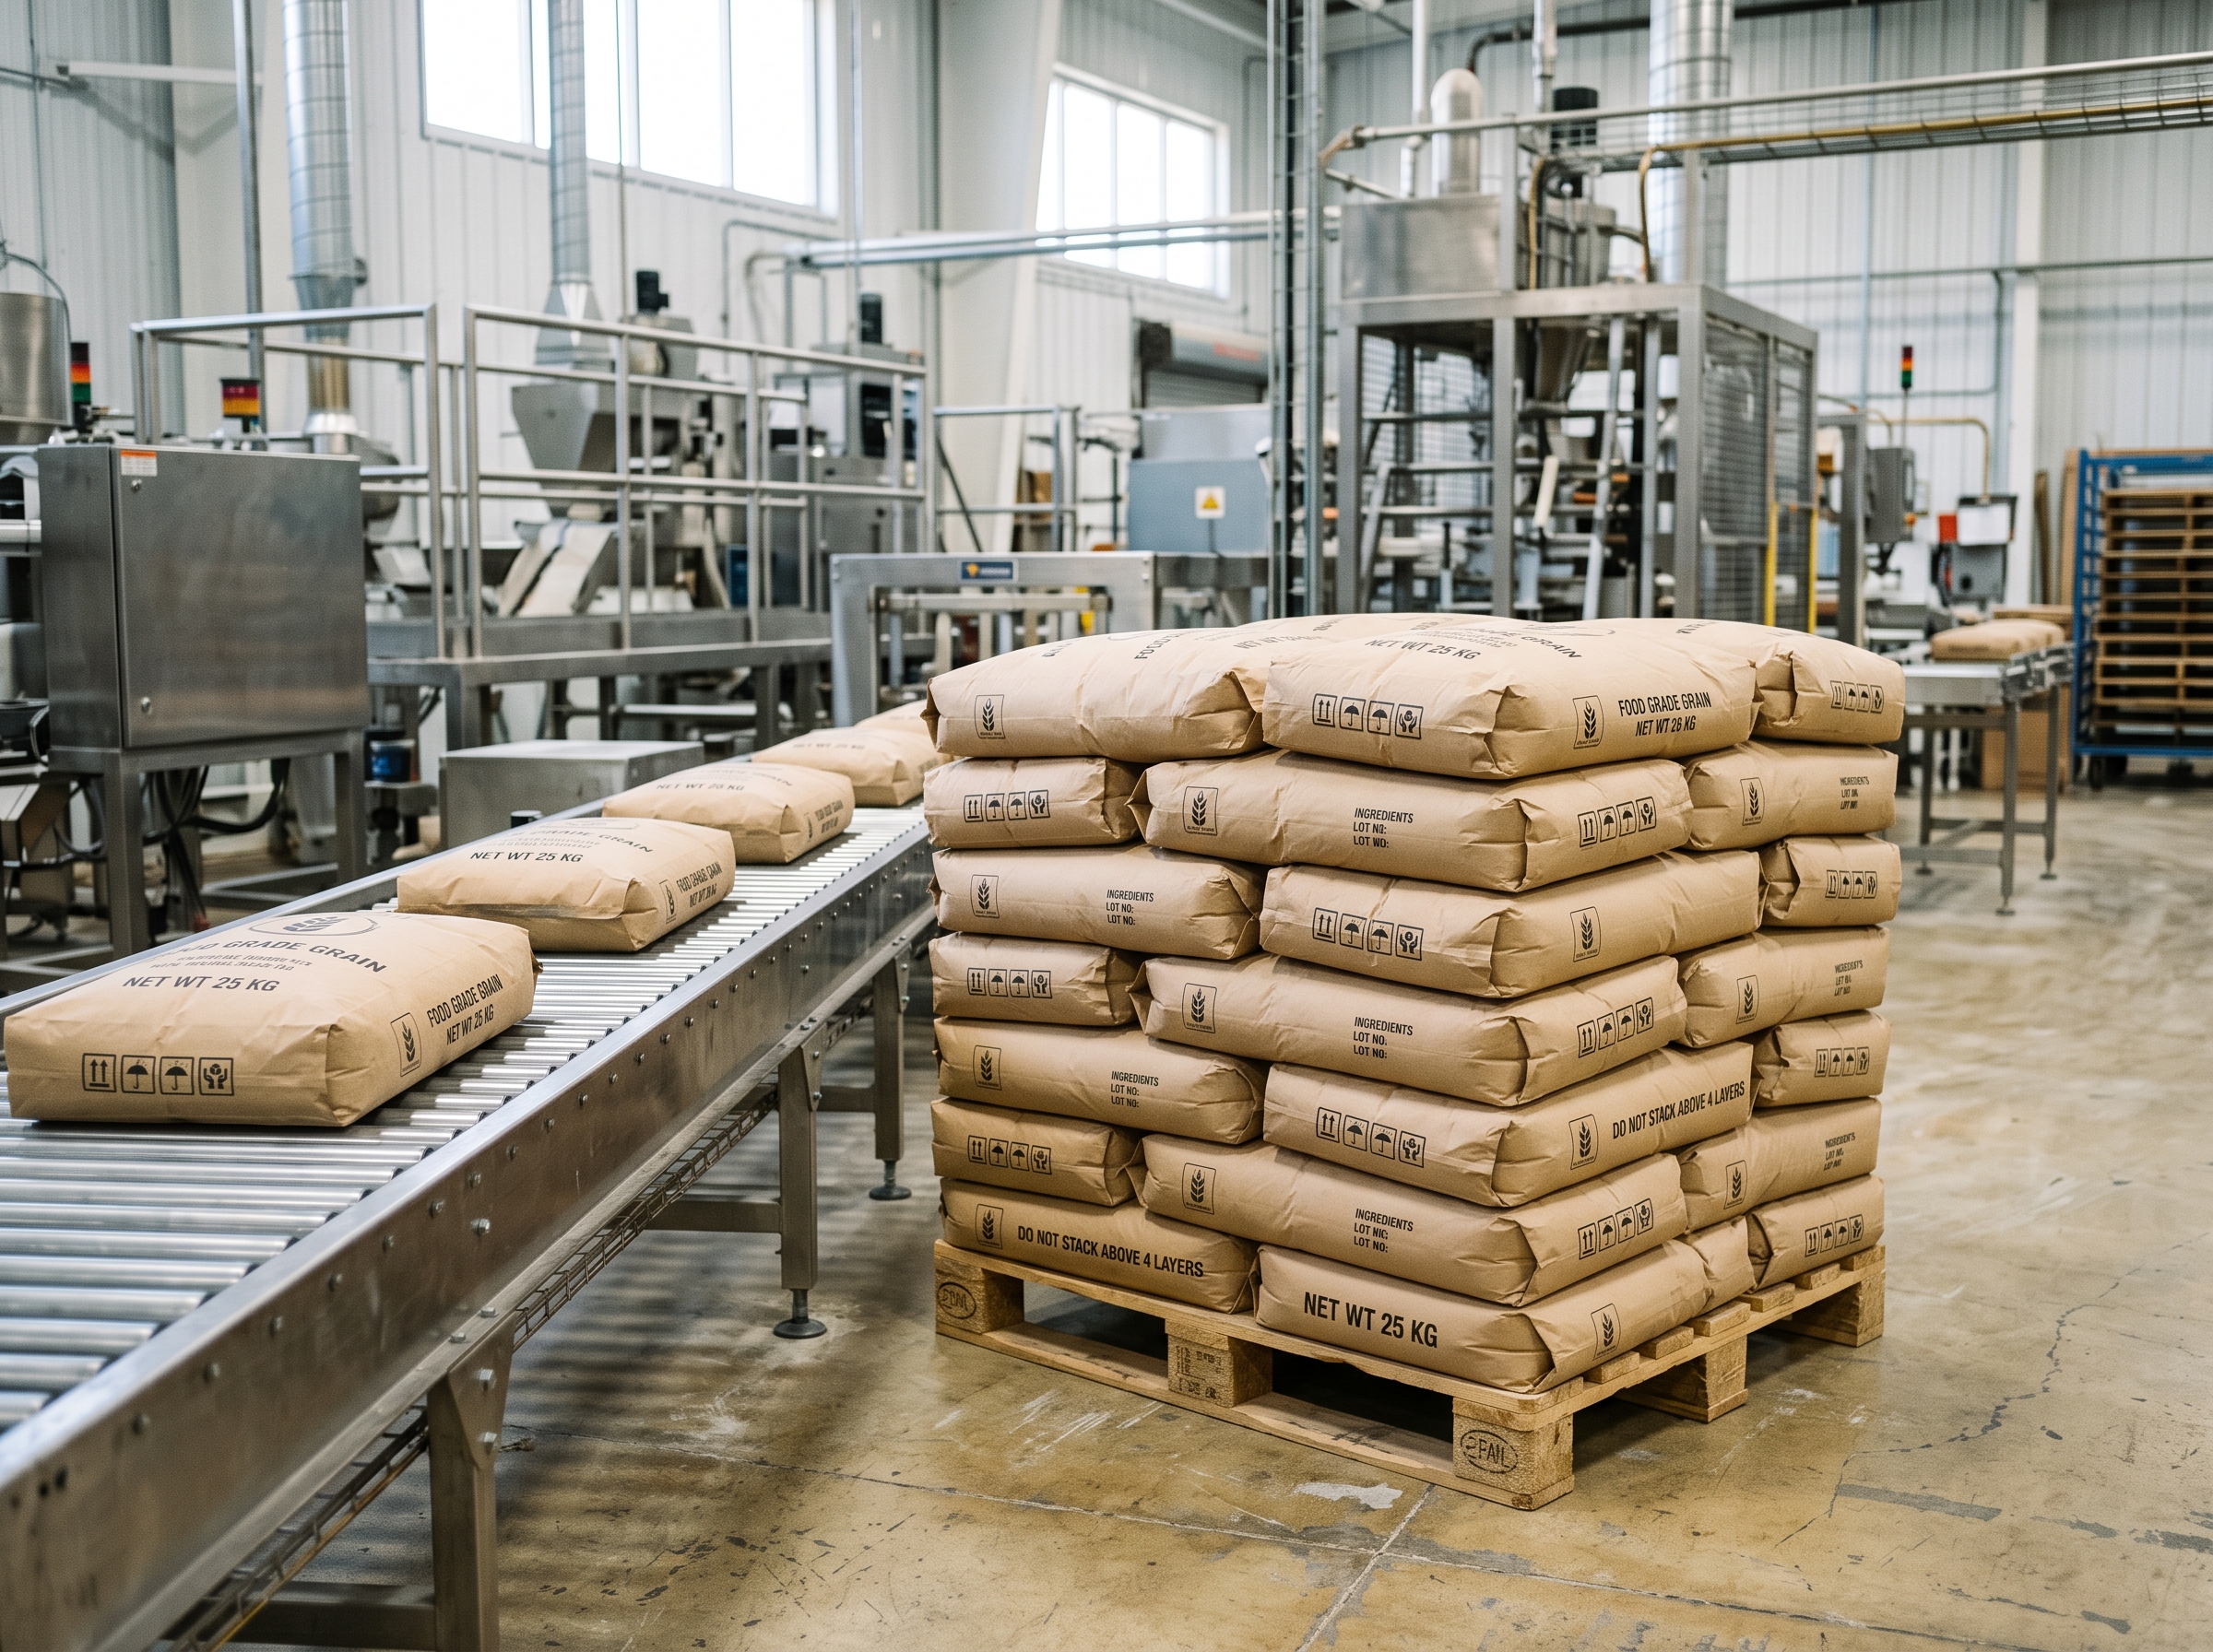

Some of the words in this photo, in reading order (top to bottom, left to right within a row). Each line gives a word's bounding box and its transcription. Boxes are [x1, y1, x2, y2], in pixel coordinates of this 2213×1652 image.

[1618, 698, 1646, 716] FOOD
[1647, 694, 1680, 714] GRADE
[1681, 691, 1711, 710] GRAIN
[1635, 719, 1653, 737] NET
[1655, 717, 1670, 734] WT
[1684, 715, 1697, 731] KG
[1354, 808, 1414, 824] INGREDIENTS
[1353, 821, 1370, 833] LOT
[1353, 835, 1371, 846] LOT
[470, 852, 504, 860] NET
[507, 852, 534, 861] WT
[535, 852, 558, 861] 25
[560, 853, 584, 863] KG
[1106, 889, 1154, 903] INGREDIENTS
[1106, 902, 1120, 912] LOT
[1121, 903, 1134, 914] NO:
[1106, 914, 1121, 925] LOT
[1122, 915, 1136, 926] NO:
[222, 940, 307, 950] GRADE
[309, 945, 387, 973] GRAIN
[123, 975, 172, 988] NET
[174, 975, 213, 988] WT
[211, 976, 243, 990] 25
[245, 978, 280, 992] KG
[426, 1001, 452, 1028] FOOD
[446, 1022, 460, 1045] NET
[461, 1015, 472, 1037] WT
[1354, 1016, 1414, 1036] INGREDIENTS
[1353, 1031, 1370, 1043] LOT
[1353, 1044, 1370, 1056] LOT
[1372, 1047, 1388, 1059] NO:
[1111, 1070, 1159, 1087] INGREDIENTS
[1110, 1083, 1125, 1094] LOT
[1126, 1085, 1140, 1096] NO:
[1110, 1095, 1125, 1106] LOT
[1126, 1098, 1140, 1108] NO:
[1612, 1119, 1627, 1139] DO
[1628, 1112, 1647, 1135] NOT
[1649, 1103, 1675, 1127] STACK
[1677, 1092, 1706, 1117] ABOVE
[1707, 1091, 1713, 1107] 4
[1714, 1080, 1745, 1105] LAYERS
[1354, 1221, 1371, 1235] LOT
[1355, 1208, 1414, 1232] INGREDIENTS
[1018, 1225, 1034, 1243] DO
[1036, 1229, 1059, 1248] NOT
[1062, 1234, 1099, 1257] STACK
[1101, 1244, 1141, 1266] ABOVE
[1143, 1252, 1151, 1268] 4
[1154, 1254, 1204, 1278] LAYERS
[1354, 1235, 1371, 1248] LOT
[1372, 1240, 1389, 1253] NO:
[1304, 1292, 1340, 1321] NET
[1345, 1302, 1376, 1330] WT
[1380, 1312, 1404, 1339] 25
[1411, 1319, 1438, 1349] KG
